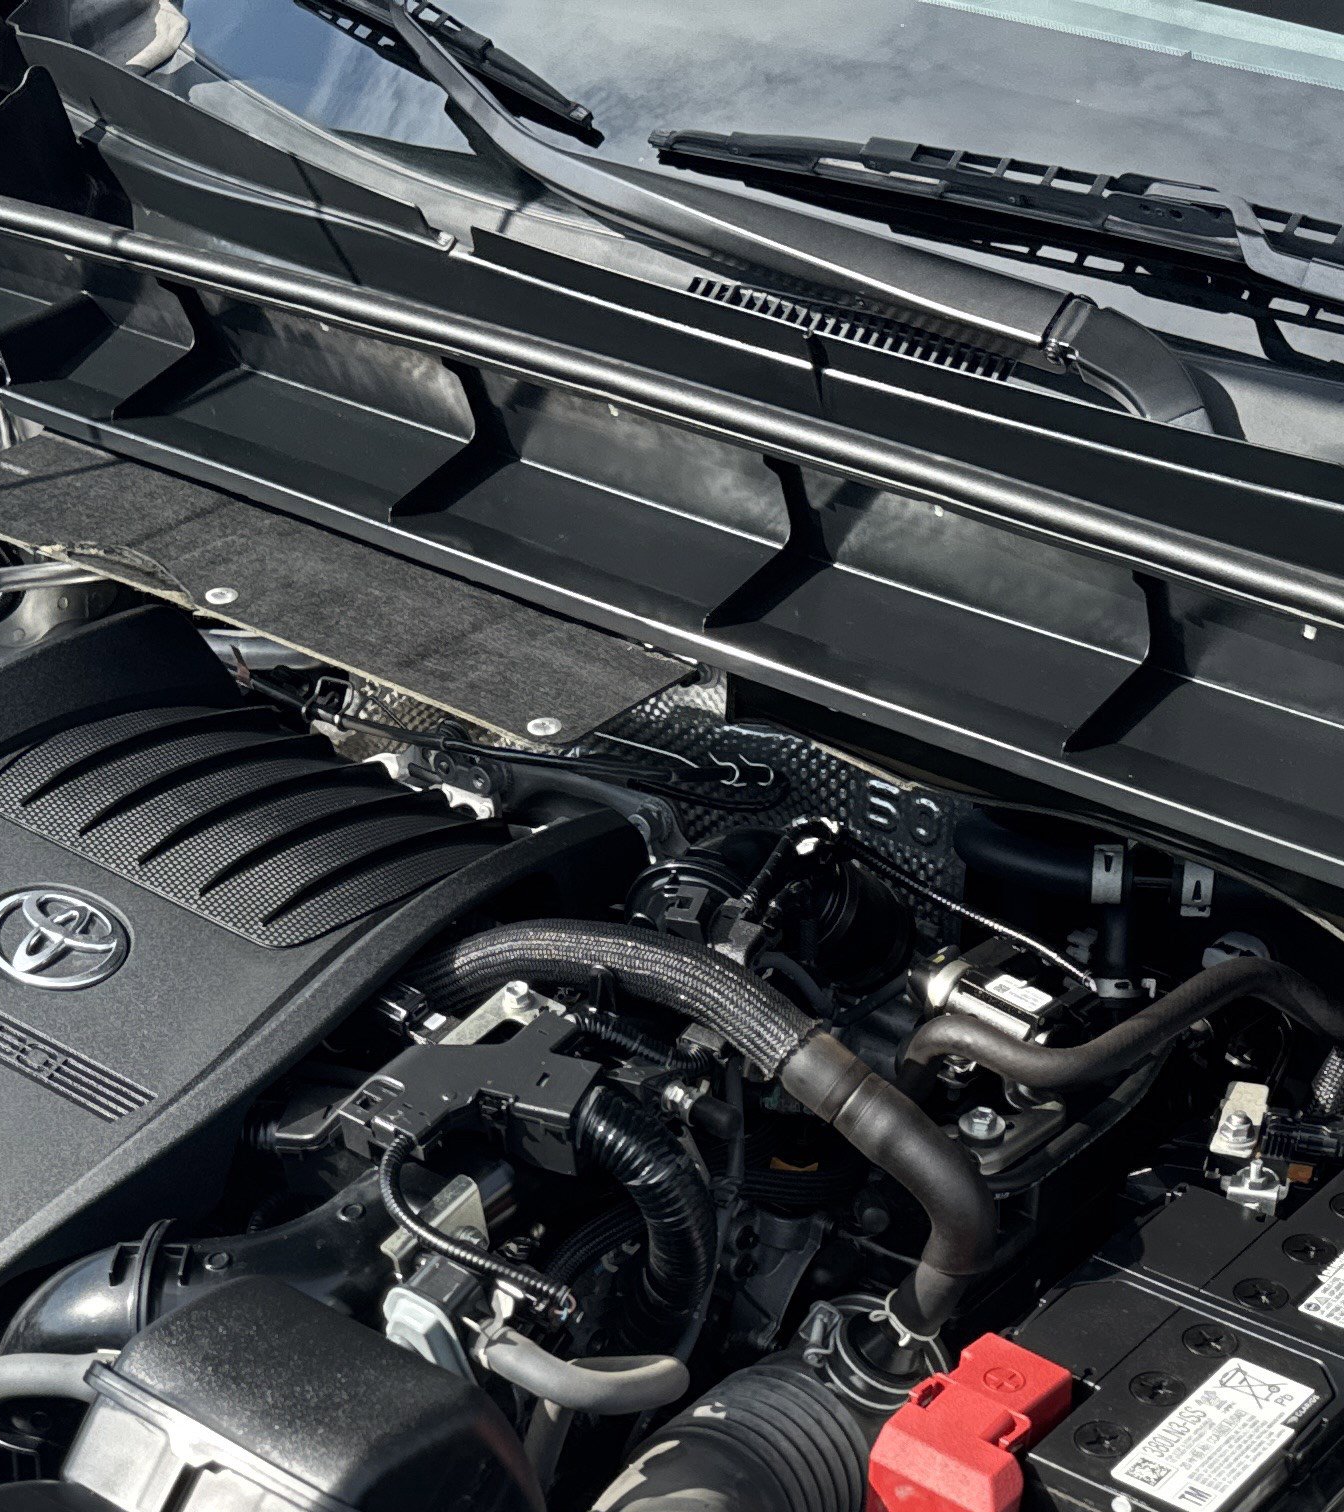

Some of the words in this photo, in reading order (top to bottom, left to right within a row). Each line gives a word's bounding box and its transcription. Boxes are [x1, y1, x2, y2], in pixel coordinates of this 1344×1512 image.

[1272, 1393, 1295, 1408] Pb
[1142, 1405, 1208, 1459] 380LN3-ISS
[1177, 1485, 1213, 1507] TM
